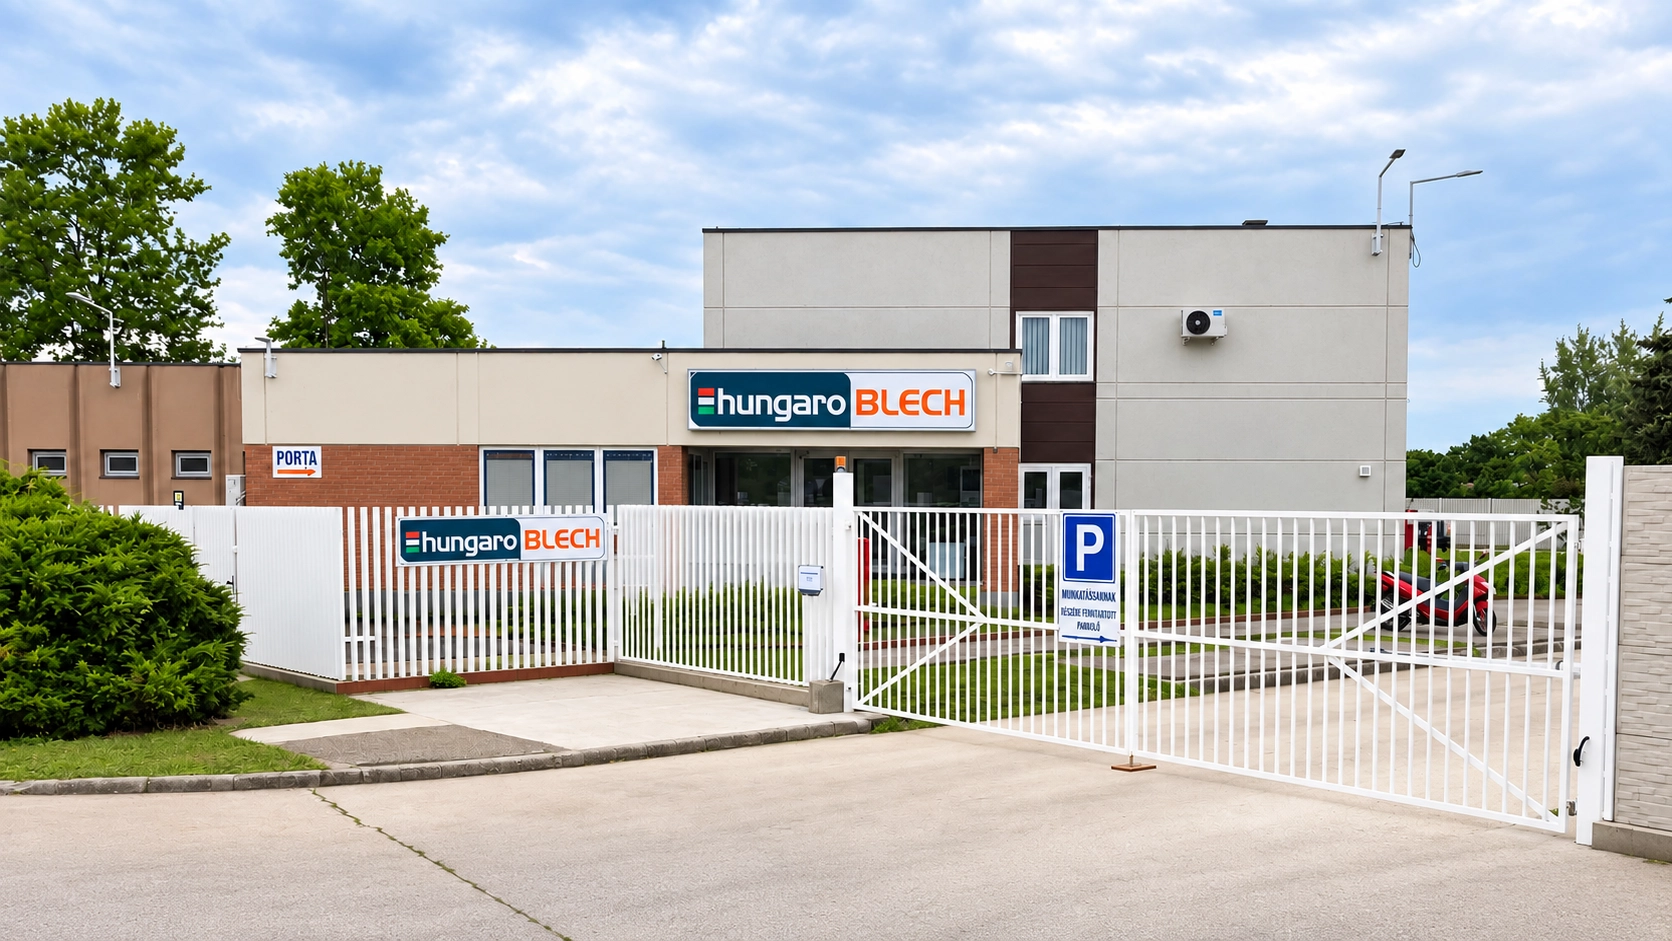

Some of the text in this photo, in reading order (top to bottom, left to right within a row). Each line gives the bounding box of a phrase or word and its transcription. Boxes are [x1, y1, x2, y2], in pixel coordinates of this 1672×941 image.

[717, 387, 966, 422] hungaro BLECH
[276, 450, 318, 466] PORTA
[422, 528, 600, 557] hungaro BLECH
[1076, 523, 1105, 572] P
